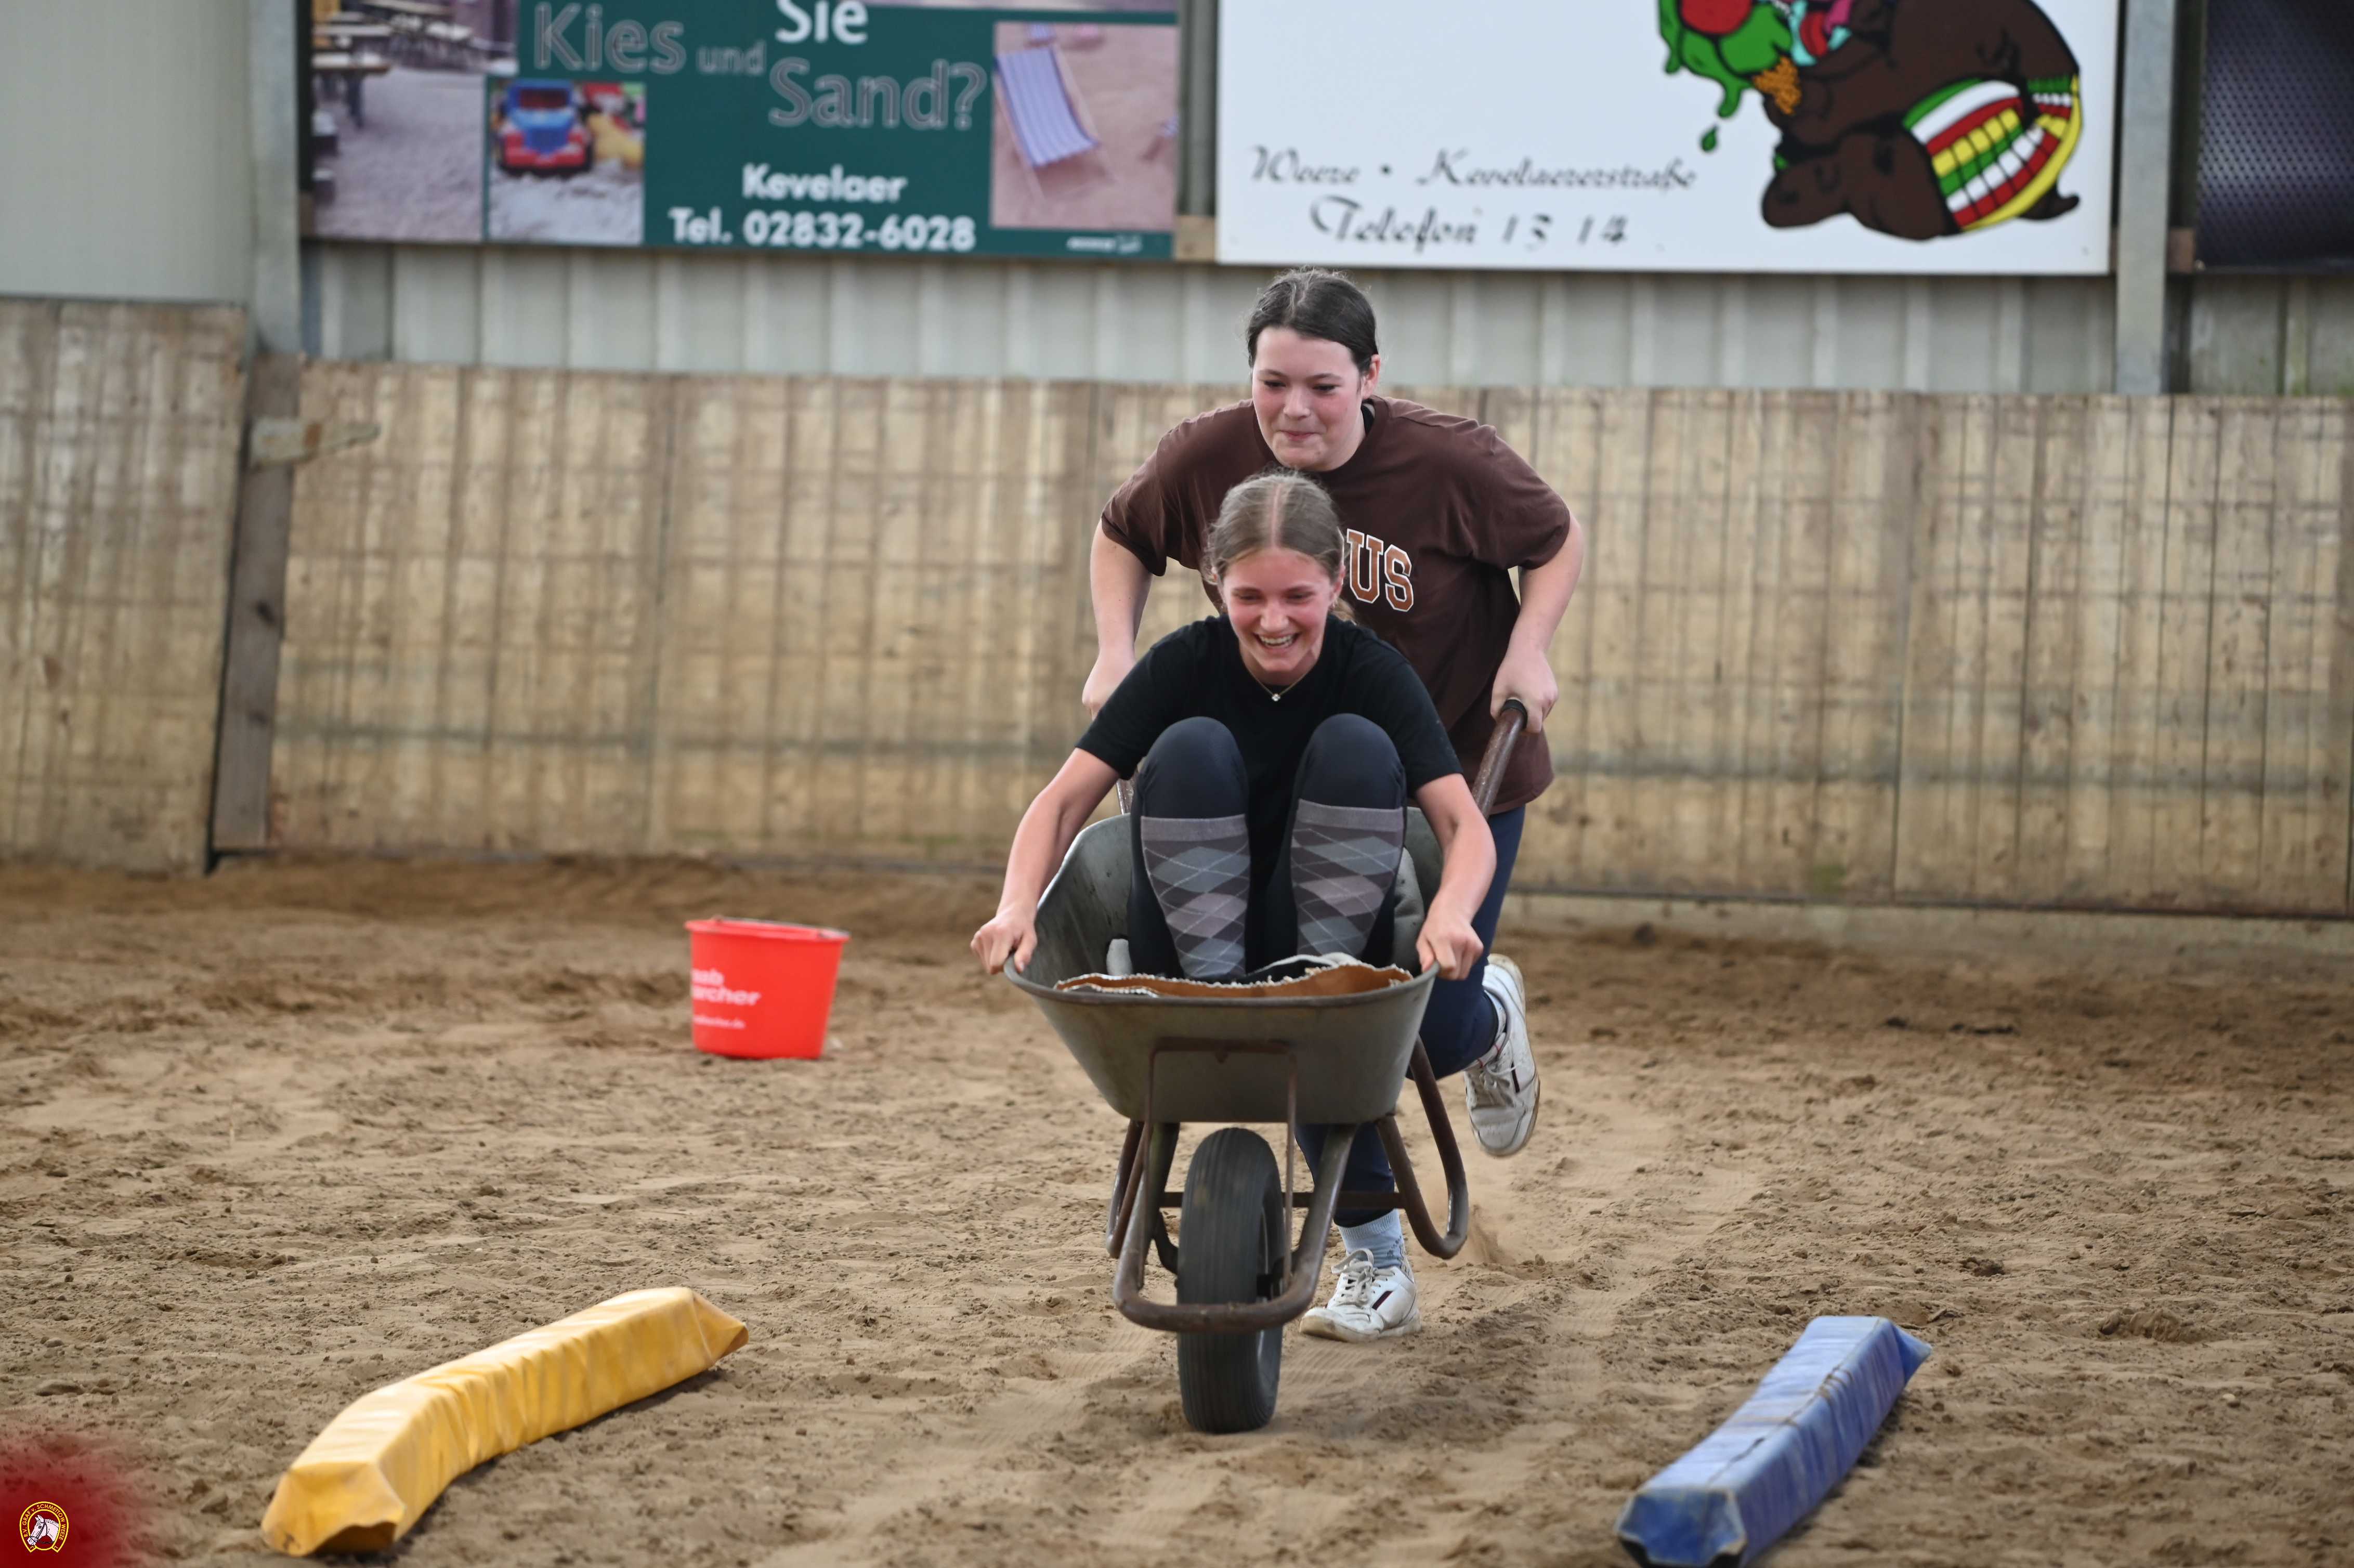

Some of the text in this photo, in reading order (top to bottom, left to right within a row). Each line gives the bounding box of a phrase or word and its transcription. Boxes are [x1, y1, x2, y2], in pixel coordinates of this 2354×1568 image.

[532, 2, 767, 76] Kies und
[775, 0, 869, 45] Sie
[768, 56, 988, 130] Sand?
[742, 162, 908, 203] Kevelaer
[669, 206, 977, 252] Tel. 02832-6028
[1310, 194, 1480, 253] Telefon
[1338, 527, 1414, 612] US
